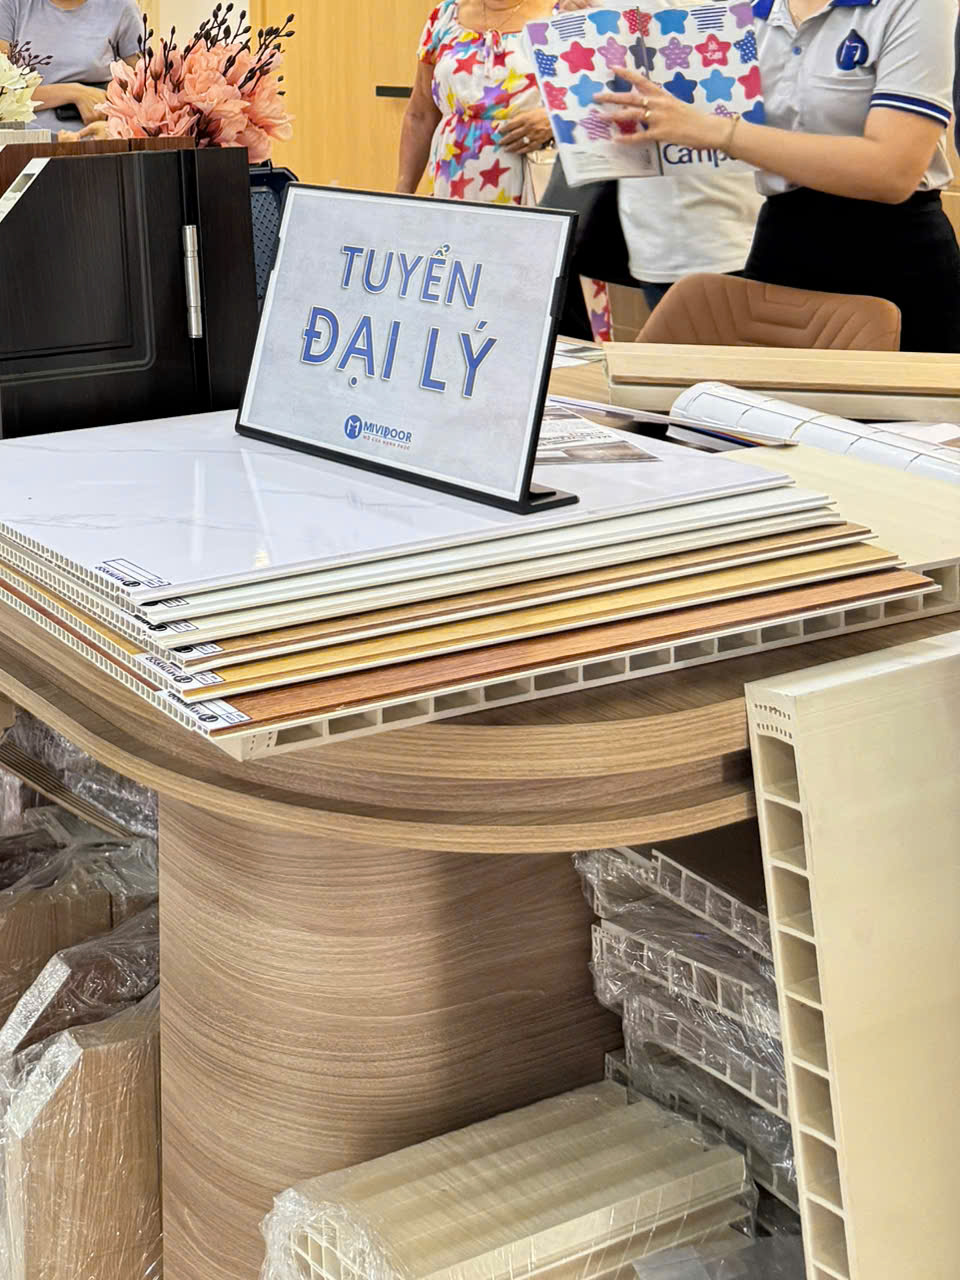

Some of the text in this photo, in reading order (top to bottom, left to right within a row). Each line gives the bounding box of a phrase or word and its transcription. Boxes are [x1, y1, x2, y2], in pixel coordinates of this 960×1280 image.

[341, 243, 484, 309] TUYỂN
[301, 305, 498, 399] ĐẠI LÝ
[363, 420, 413, 443] MIVIDOOR
